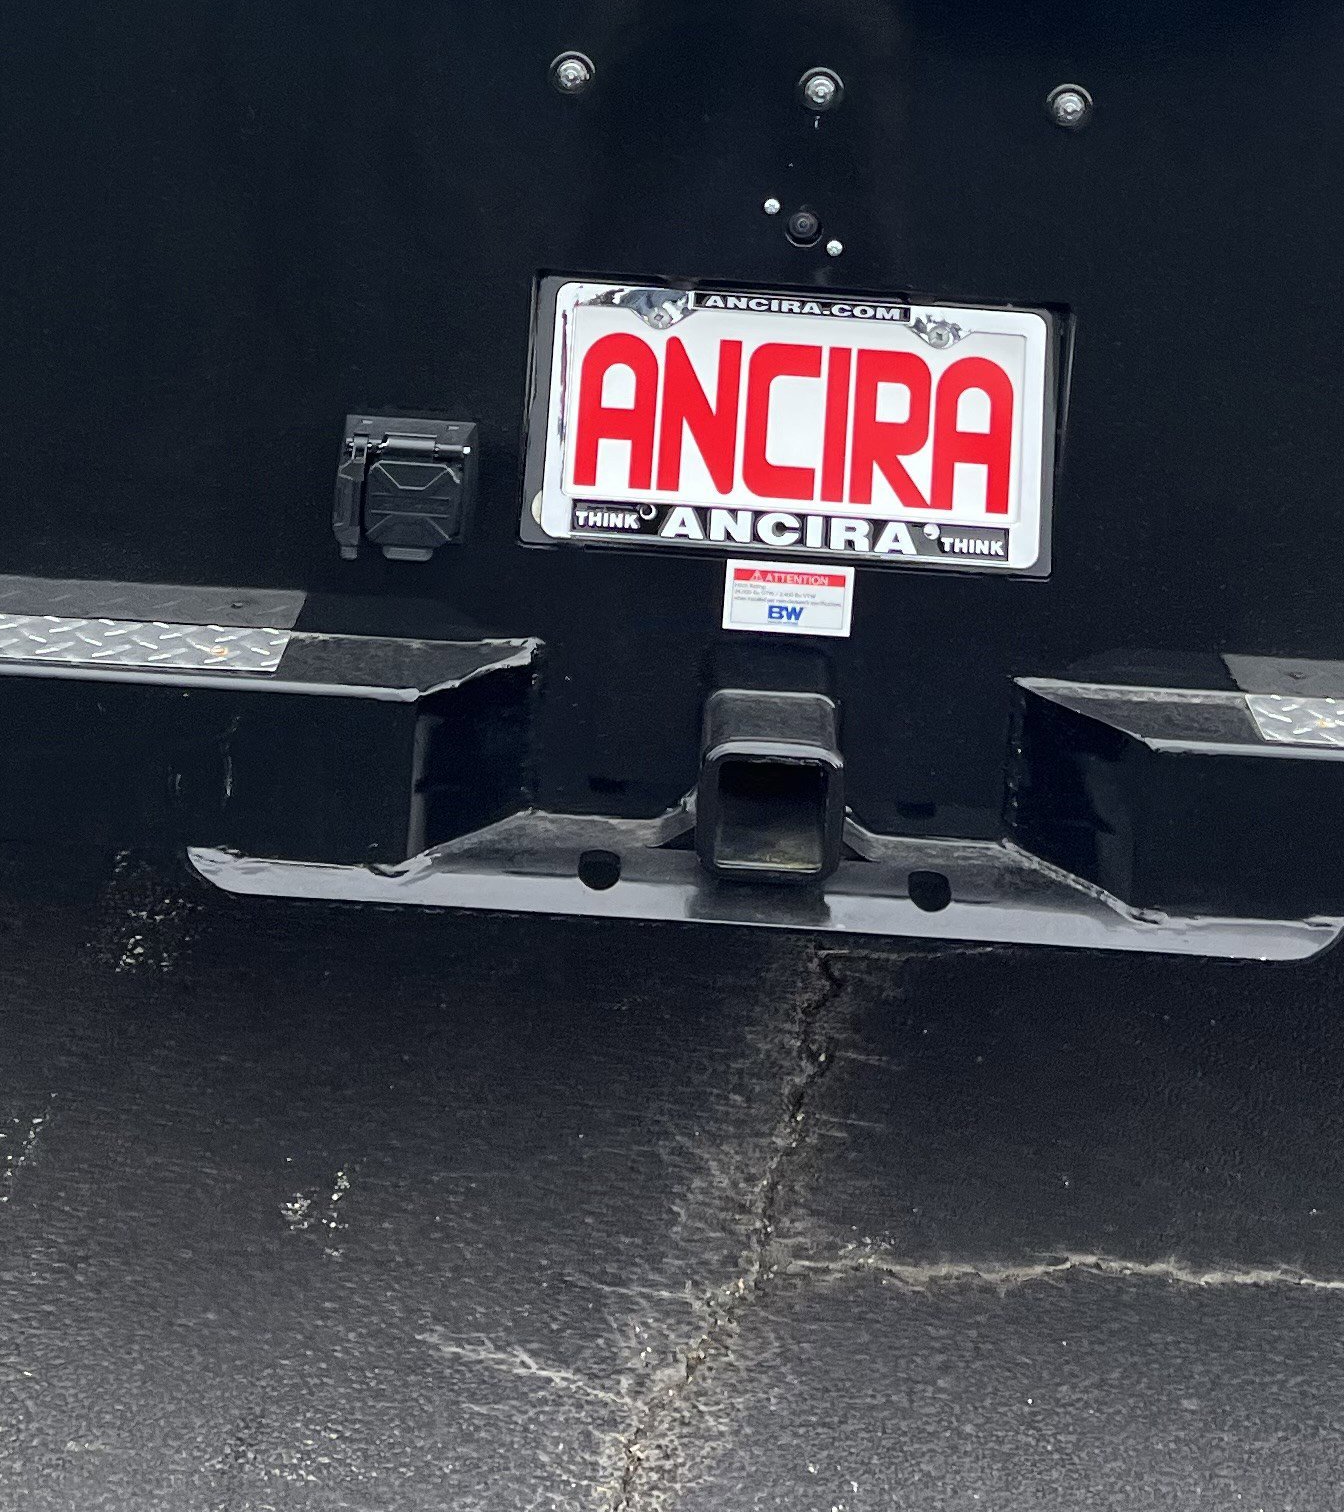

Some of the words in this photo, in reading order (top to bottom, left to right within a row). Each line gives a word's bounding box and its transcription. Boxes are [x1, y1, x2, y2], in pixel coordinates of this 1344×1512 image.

[702, 294, 902, 321] ANCIRA.COM
[572, 332, 1015, 515] ANCIRA
[575, 508, 641, 531] THINK
[659, 507, 918, 556] ANCIRA
[939, 536, 1005, 557] THINK
[765, 572, 830, 586] ATTENTION
